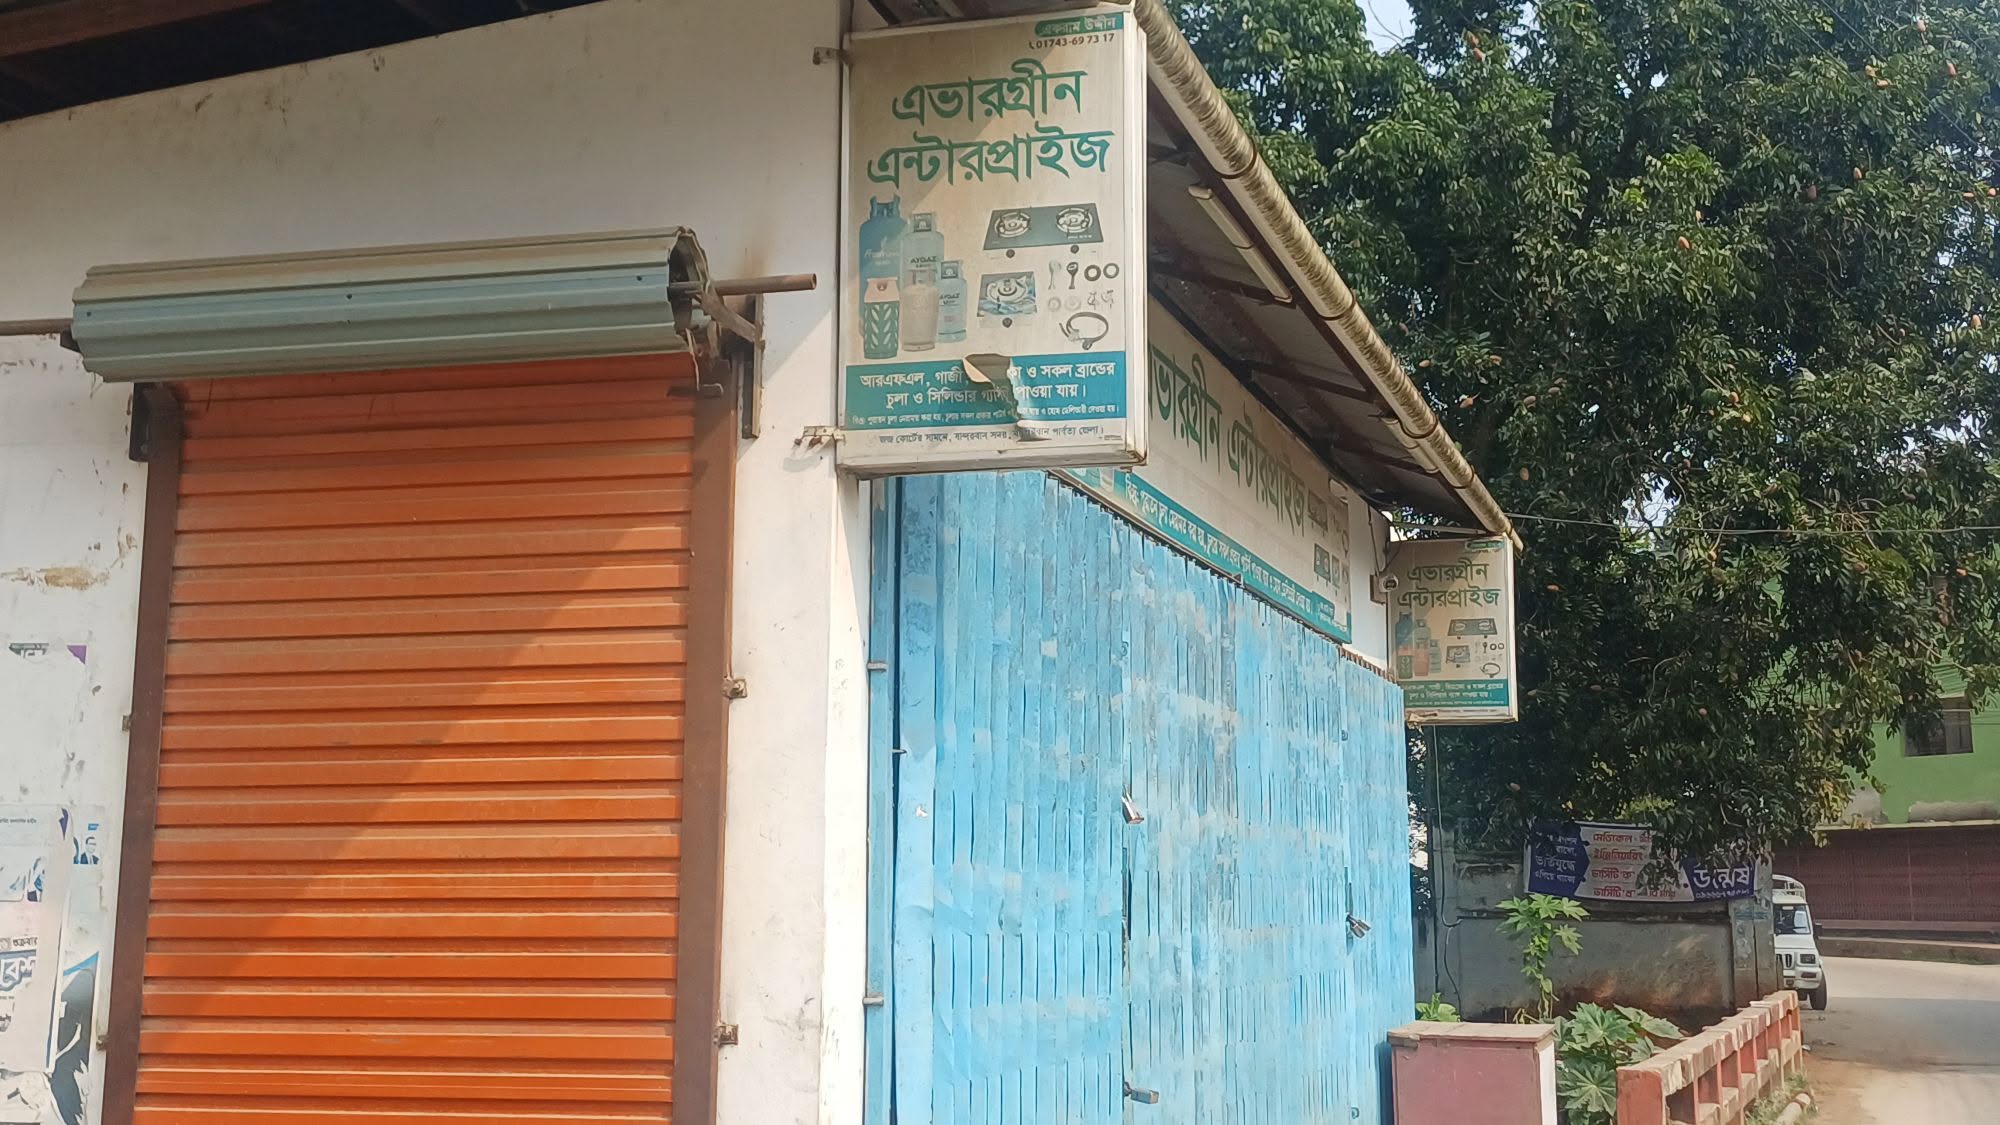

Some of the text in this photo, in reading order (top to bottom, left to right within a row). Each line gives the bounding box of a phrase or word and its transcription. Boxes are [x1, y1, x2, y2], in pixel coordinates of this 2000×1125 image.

[891, 58, 1088, 126] এভারগ্রীন
[867, 121, 1115, 189] এন্টারপ্রাইজ
[1027, 366, 1037, 378] ও
[1040, 364, 1073, 378] সকল
[886, 392, 909, 409] চুলা
[913, 392, 923, 404] ও
[927, 387, 977, 405] সিলিন্ডার
[1013, 385, 1052, 399] পাওয়া
[1228, 400, 1305, 537] এন্টারপ্রাইজ
[1407, 557, 1489, 584] এভারগ্রীন
[1397, 585, 1501, 609] এন্টারপ্রাইজ
